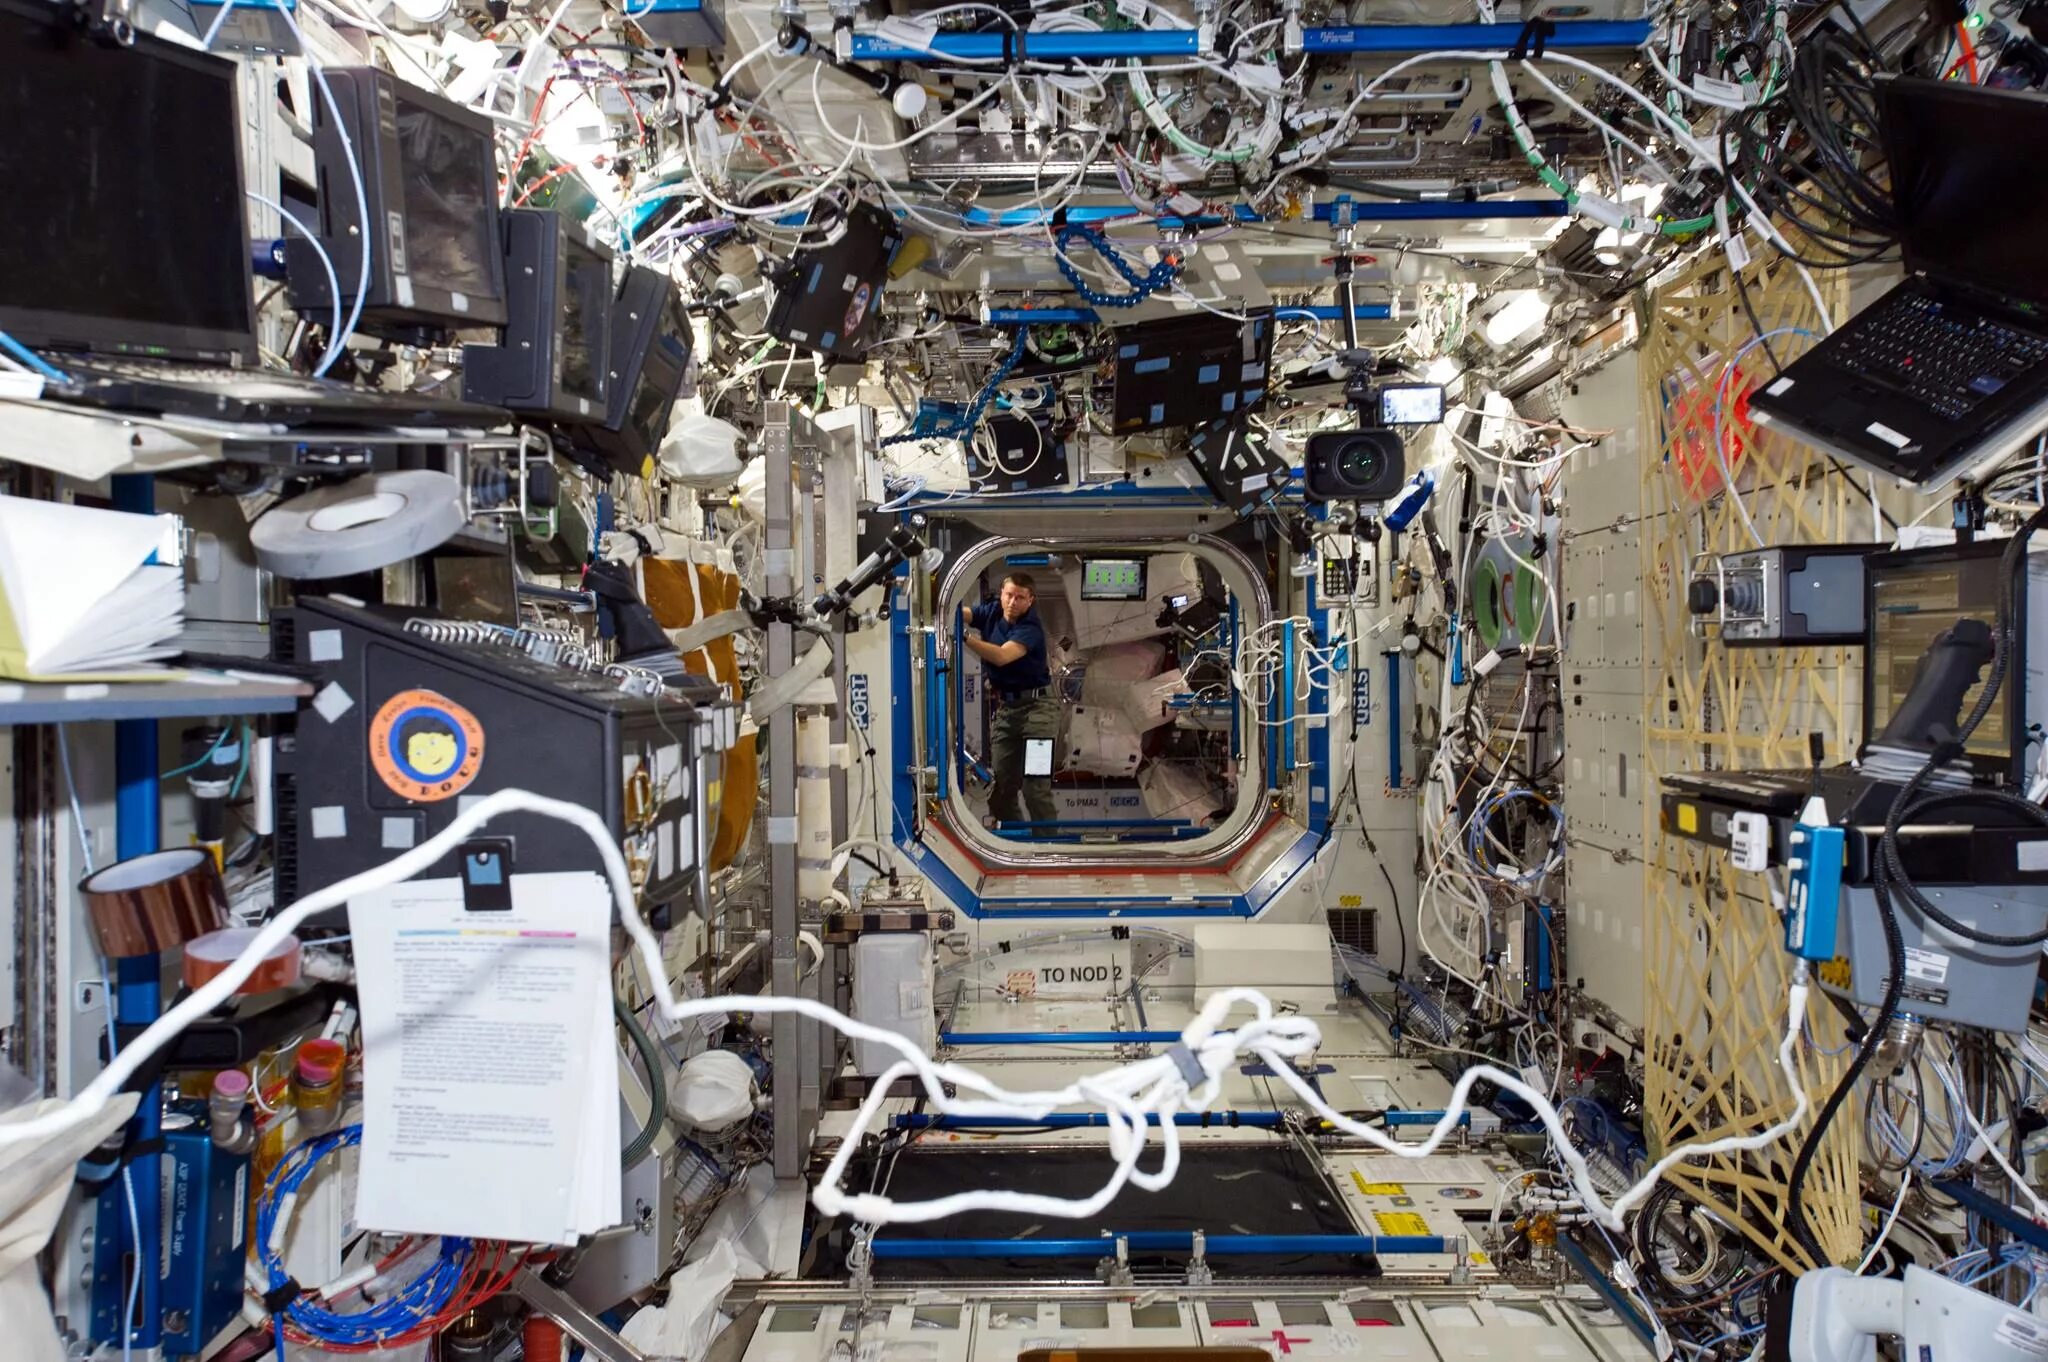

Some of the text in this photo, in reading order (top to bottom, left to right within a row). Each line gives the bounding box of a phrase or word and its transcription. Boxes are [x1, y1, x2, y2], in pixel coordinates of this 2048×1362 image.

[852, 675, 868, 728] PORT
[1066, 797, 1099, 807] To PMA2
[1041, 967, 1065, 984] TO
[1070, 966, 1108, 982] NOD
[1113, 965, 1123, 981] 2
[175, 1209, 187, 1231] Power
[172, 1234, 186, 1257] Supply
